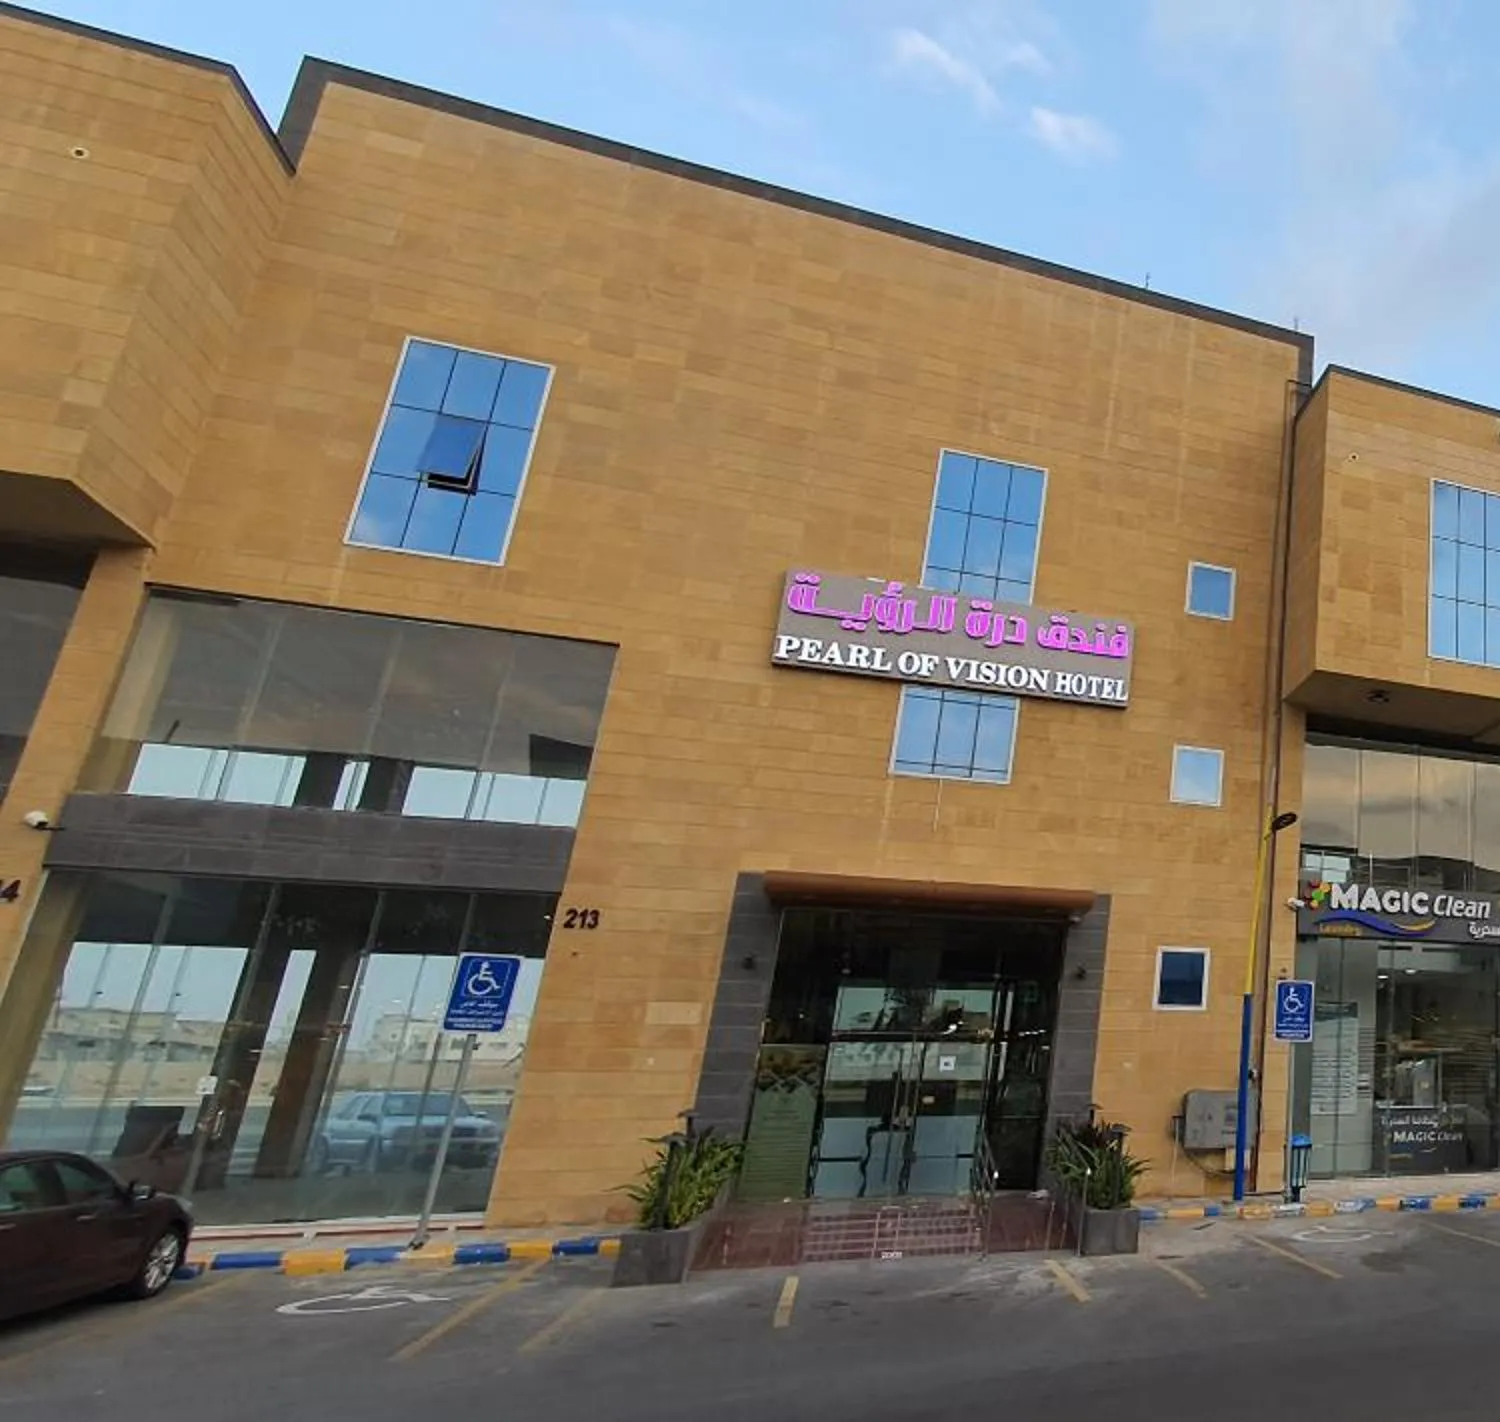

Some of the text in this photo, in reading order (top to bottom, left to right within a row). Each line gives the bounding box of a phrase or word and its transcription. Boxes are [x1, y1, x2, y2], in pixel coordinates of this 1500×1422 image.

[787, 573, 1130, 658] فندق درة الرؤية
[774, 635, 1129, 701] PEARL OF VISION HOTEL
[563, 907, 600, 929] 213
[1330, 883, 1492, 919] MAGIC Clean
[1393, 1131, 1437, 1143] MAGIC
